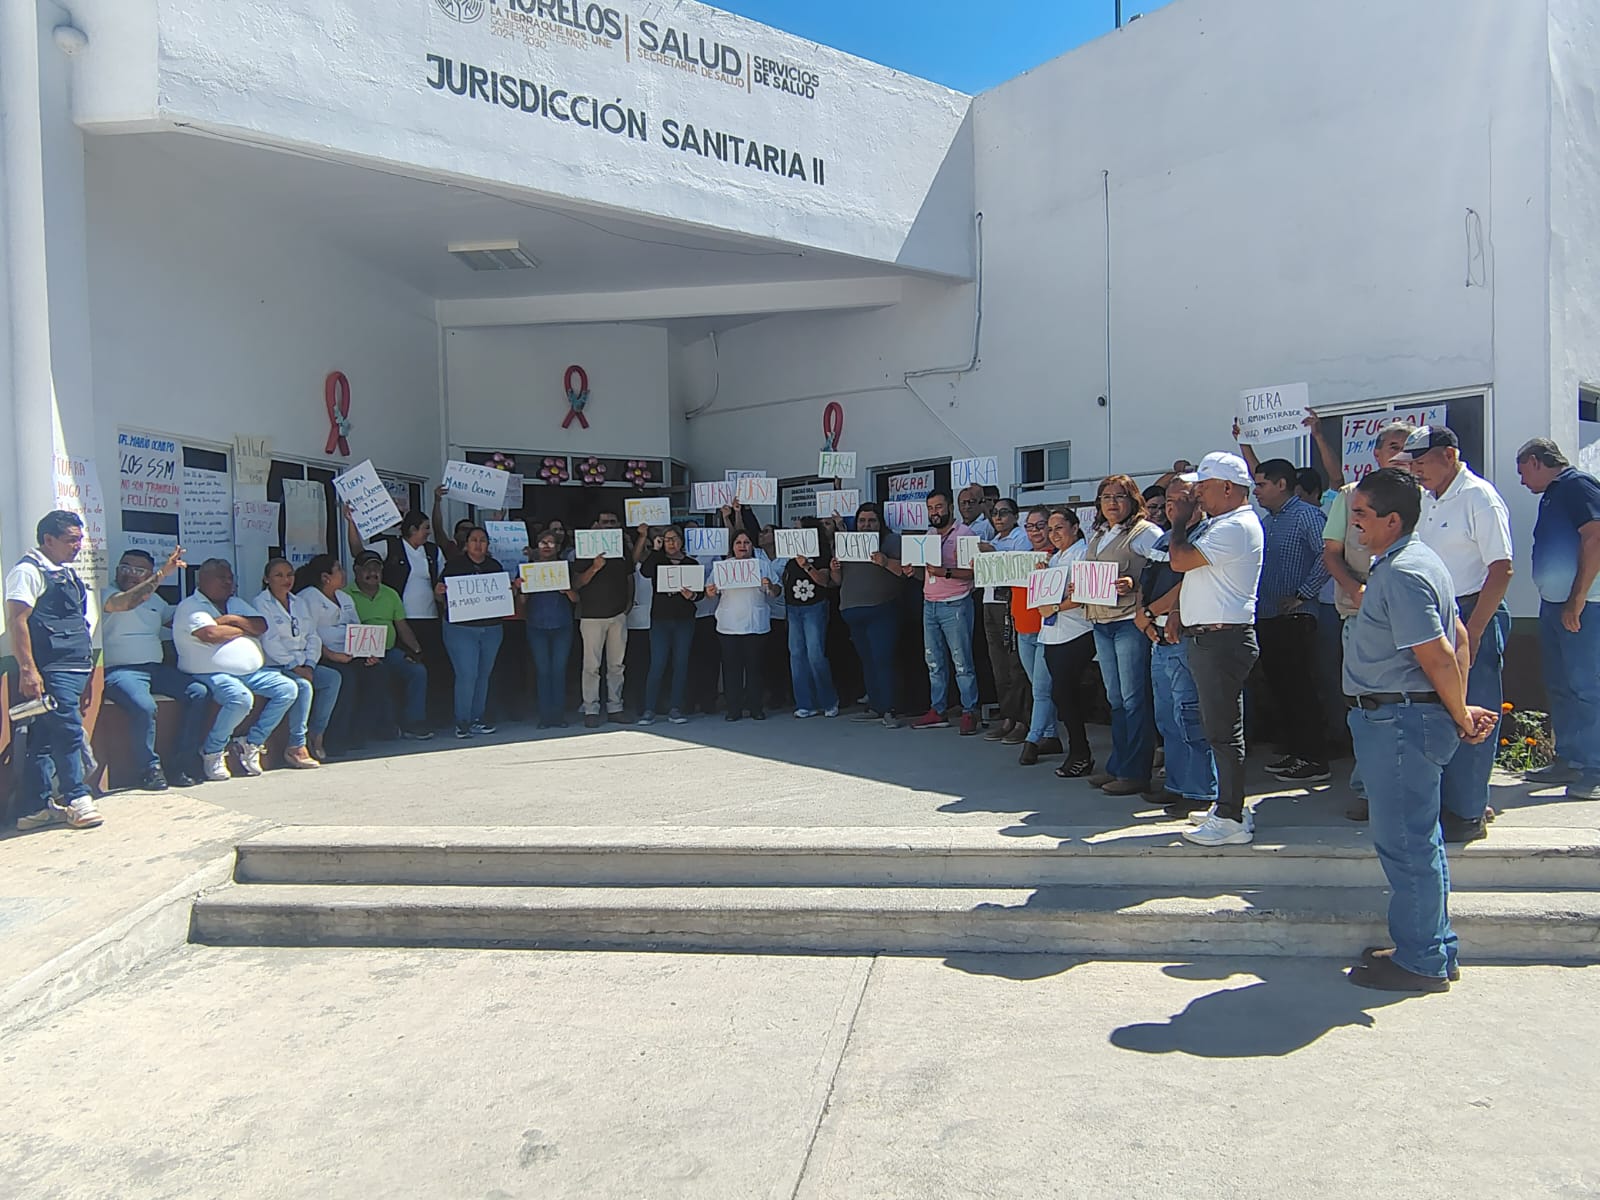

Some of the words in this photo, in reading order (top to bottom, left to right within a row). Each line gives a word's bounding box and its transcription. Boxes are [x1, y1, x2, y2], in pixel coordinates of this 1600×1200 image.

[490, 8, 502, 19] LA
[504, 9, 539, 28] TIERRA
[540, 19, 564, 36] QUE
[565, 26, 587, 42] NOS
[591, 34, 613, 49] UNE
[490, 16, 535, 36] GOBIERNO
[538, 29, 554, 42] DEL
[490, 26, 514, 41] 2024
[522, 35, 547, 50] 2030
[638, 19, 742, 77] SALUD
[637, 48, 698, 75] SECRETARIA
[701, 66, 714, 80] DE
[714, 71, 745, 89] SALUD
[753, 56, 820, 88] SERVICIOS
[754, 71, 770, 87] DE
[772, 76, 815, 100] SALUD
[426, 53, 648, 142] JURISDICCIÓN
[661, 119, 807, 182] SANITARIA
[812, 157, 826, 186] II
[1245, 392, 1282, 411] FUERA
[120, 453, 143, 475] LOS
[146, 458, 175, 480] SSM
[820, 453, 854, 476] FUERA
[953, 457, 998, 485] FUERA
[58, 484, 81, 498] HUGO
[887, 502, 923, 529] FUERA
[577, 531, 620, 555] FUERA
[776, 530, 817, 555] MARIO
[836, 533, 878, 560] OCAMPO
[913, 537, 928, 564] Y
[667, 567, 692, 588] EL
[716, 560, 760, 585] DOCTOR
[1072, 562, 1118, 600] MENDOZA
[457, 578, 499, 596] FUERA
[1029, 569, 1063, 604] HUGO
